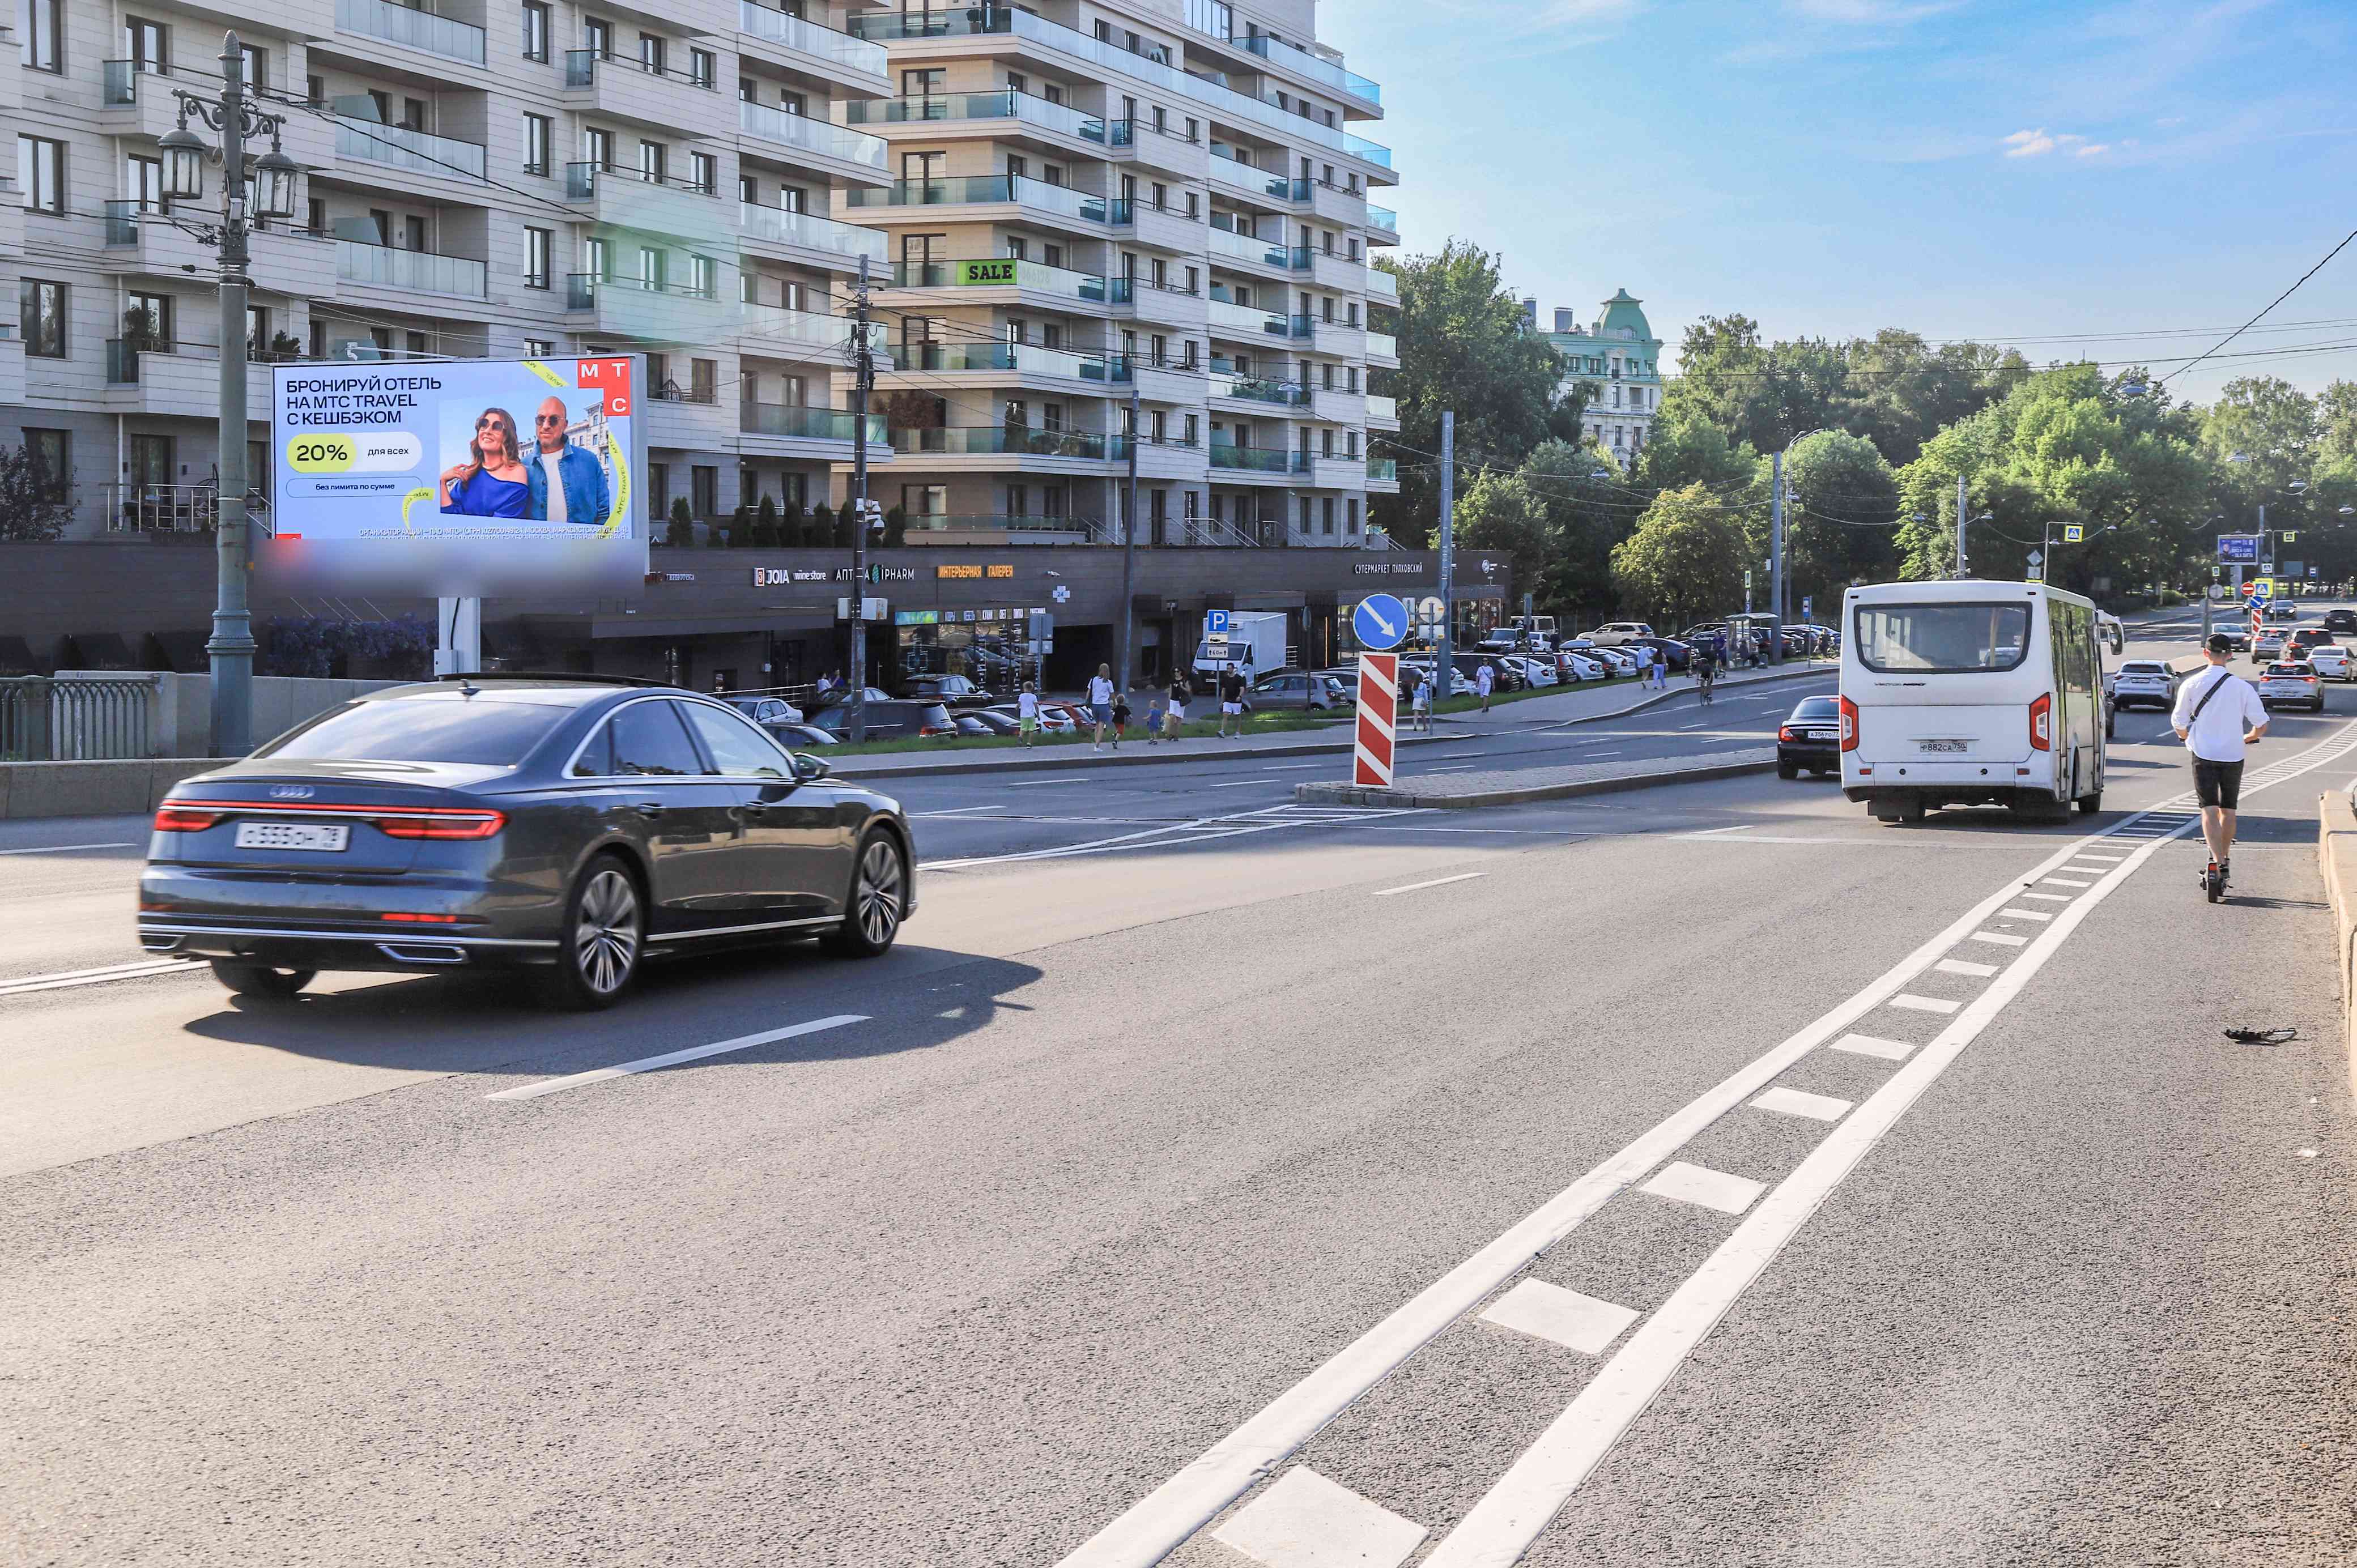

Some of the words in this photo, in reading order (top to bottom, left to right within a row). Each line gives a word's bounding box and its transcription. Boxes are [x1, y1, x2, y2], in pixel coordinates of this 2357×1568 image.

[969, 264, 1012, 280] SALE
[287, 375, 380, 393] БРОНИРУЙ
[384, 377, 441, 390] ОТЕЛЬ
[287, 397, 310, 408] НА
[314, 396, 350, 408] МТС
[353, 394, 418, 407] TRAVEL
[287, 412, 299, 425] С
[302, 411, 401, 424] КЕШБЭКОМ
[296, 444, 348, 461] 20%
[368, 448, 385, 457] для
[836, 568, 870, 581] АПТА
[938, 565, 982, 578] ИНТЕРЬЕРНАЯ
[988, 565, 1013, 577] ГАЛЕРЕЯ
[1355, 564, 1390, 573] СУПЕРМАРКЕТ
[1392, 562, 1423, 573] ПУЛКОВСКИЙ
[765, 569, 790, 585] JOIA
